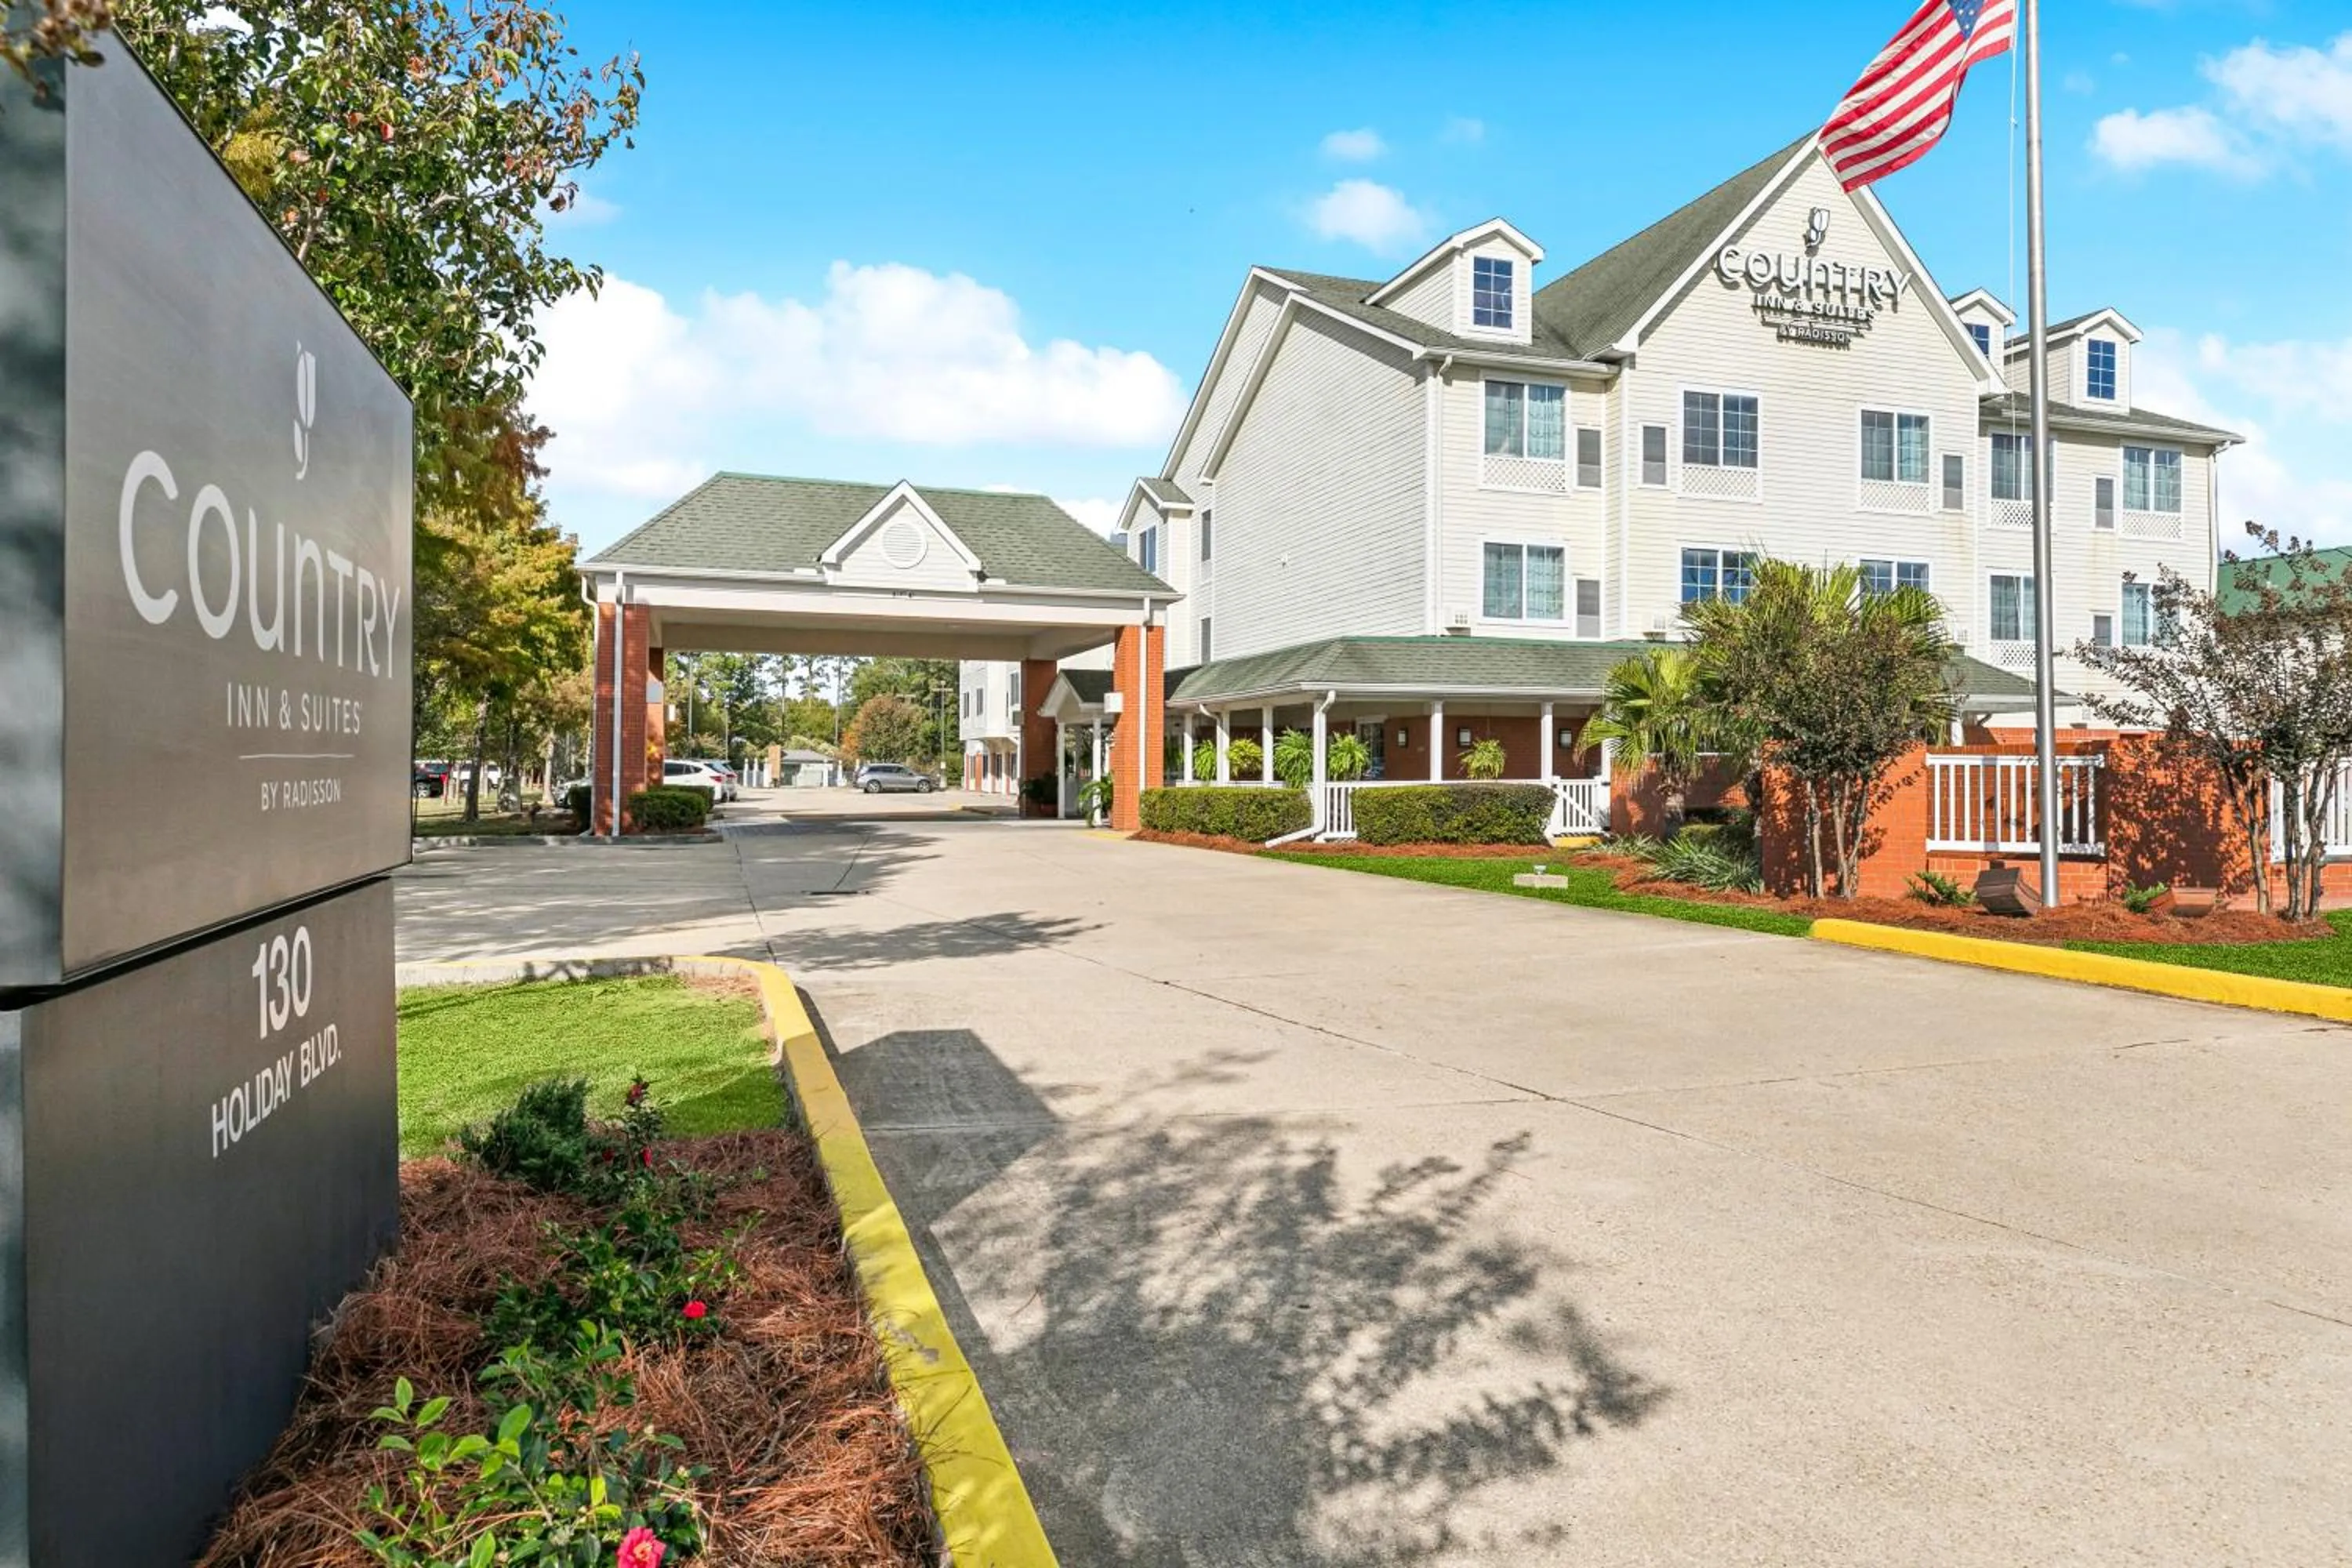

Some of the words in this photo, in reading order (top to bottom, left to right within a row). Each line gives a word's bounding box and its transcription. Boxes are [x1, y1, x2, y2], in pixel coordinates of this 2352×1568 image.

[1755, 292, 1787, 310] INN
[1815, 301, 1876, 321] SUITES
[1778, 323, 1796, 336] BY
[1798, 326, 1851, 343] RADISSON
[227, 681, 270, 728] INN
[278, 688, 292, 731] &
[300, 691, 362, 735] SUITES
[260, 781, 279, 811] BY
[282, 777, 341, 809] RADISSON
[252, 926, 312, 1040] 130
[212, 1051, 294, 1158] HOLIDAY
[299, 1023, 342, 1088] BLVD.
